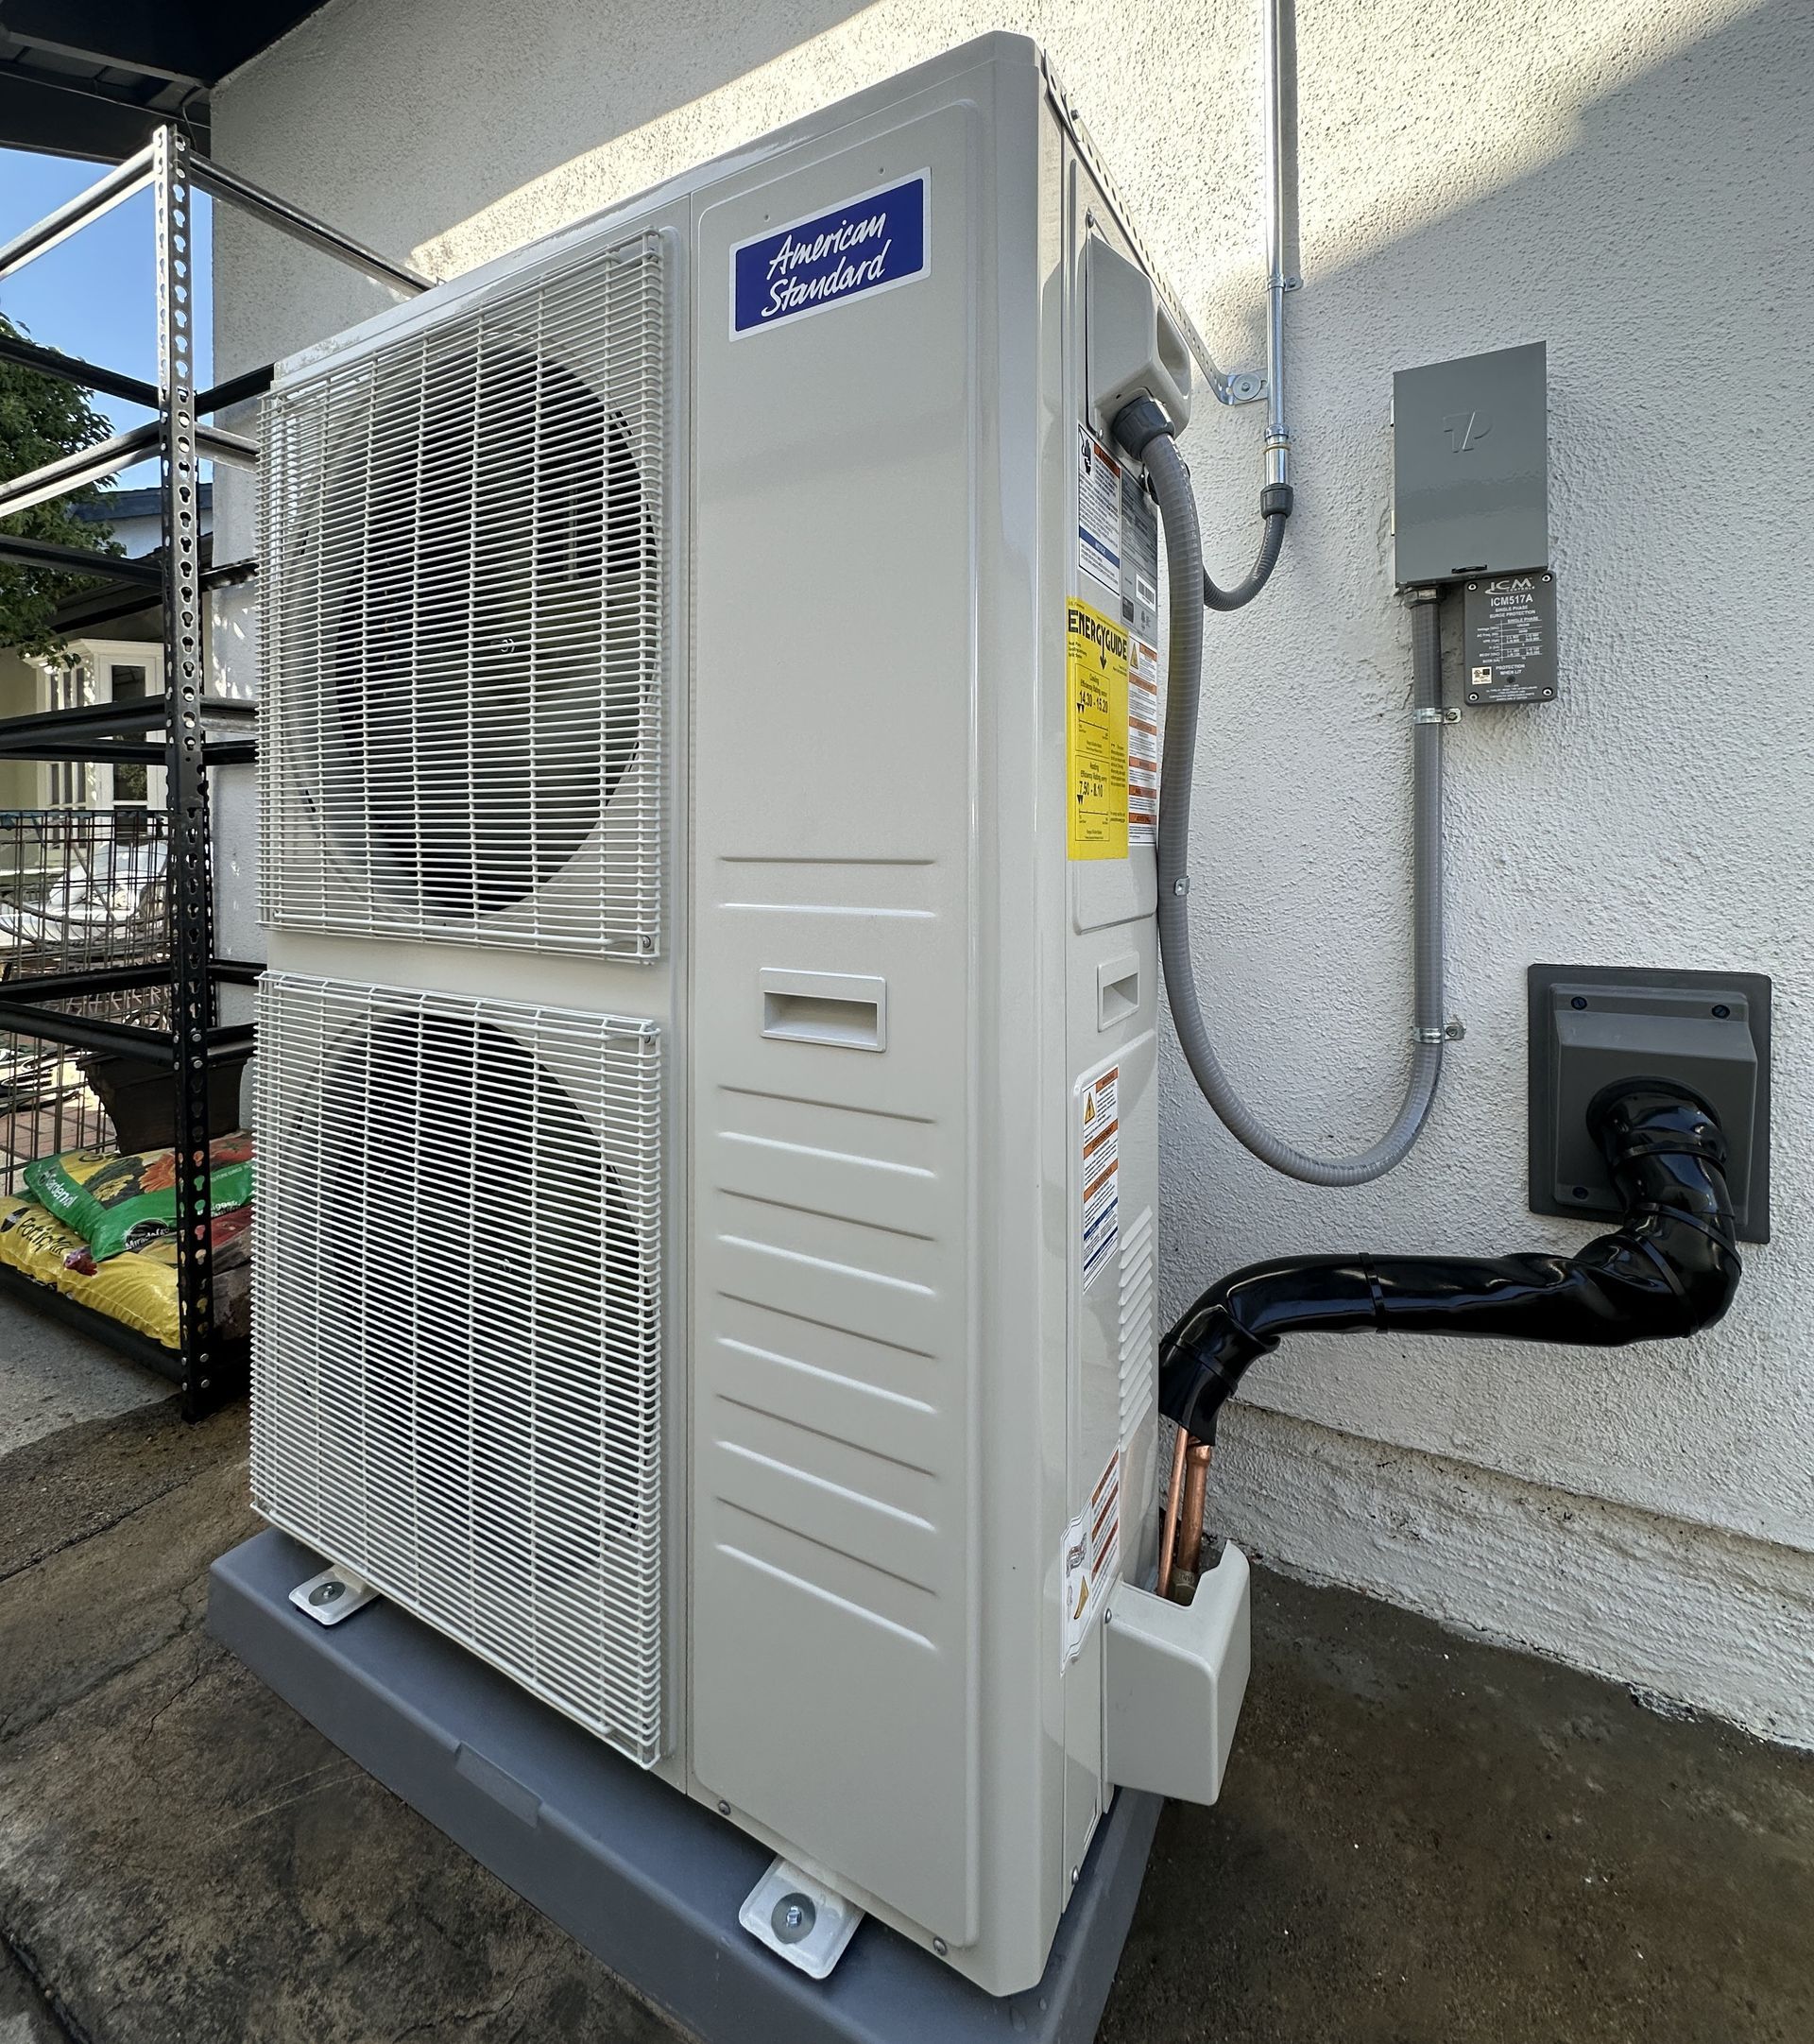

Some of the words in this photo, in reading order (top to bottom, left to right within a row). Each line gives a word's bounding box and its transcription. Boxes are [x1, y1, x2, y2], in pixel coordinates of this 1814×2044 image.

[766, 213, 886, 280] American
[761, 239, 892, 317] Standard
[1490, 578, 1532, 591] ICM
[1491, 593, 1532, 607] ICM517A
